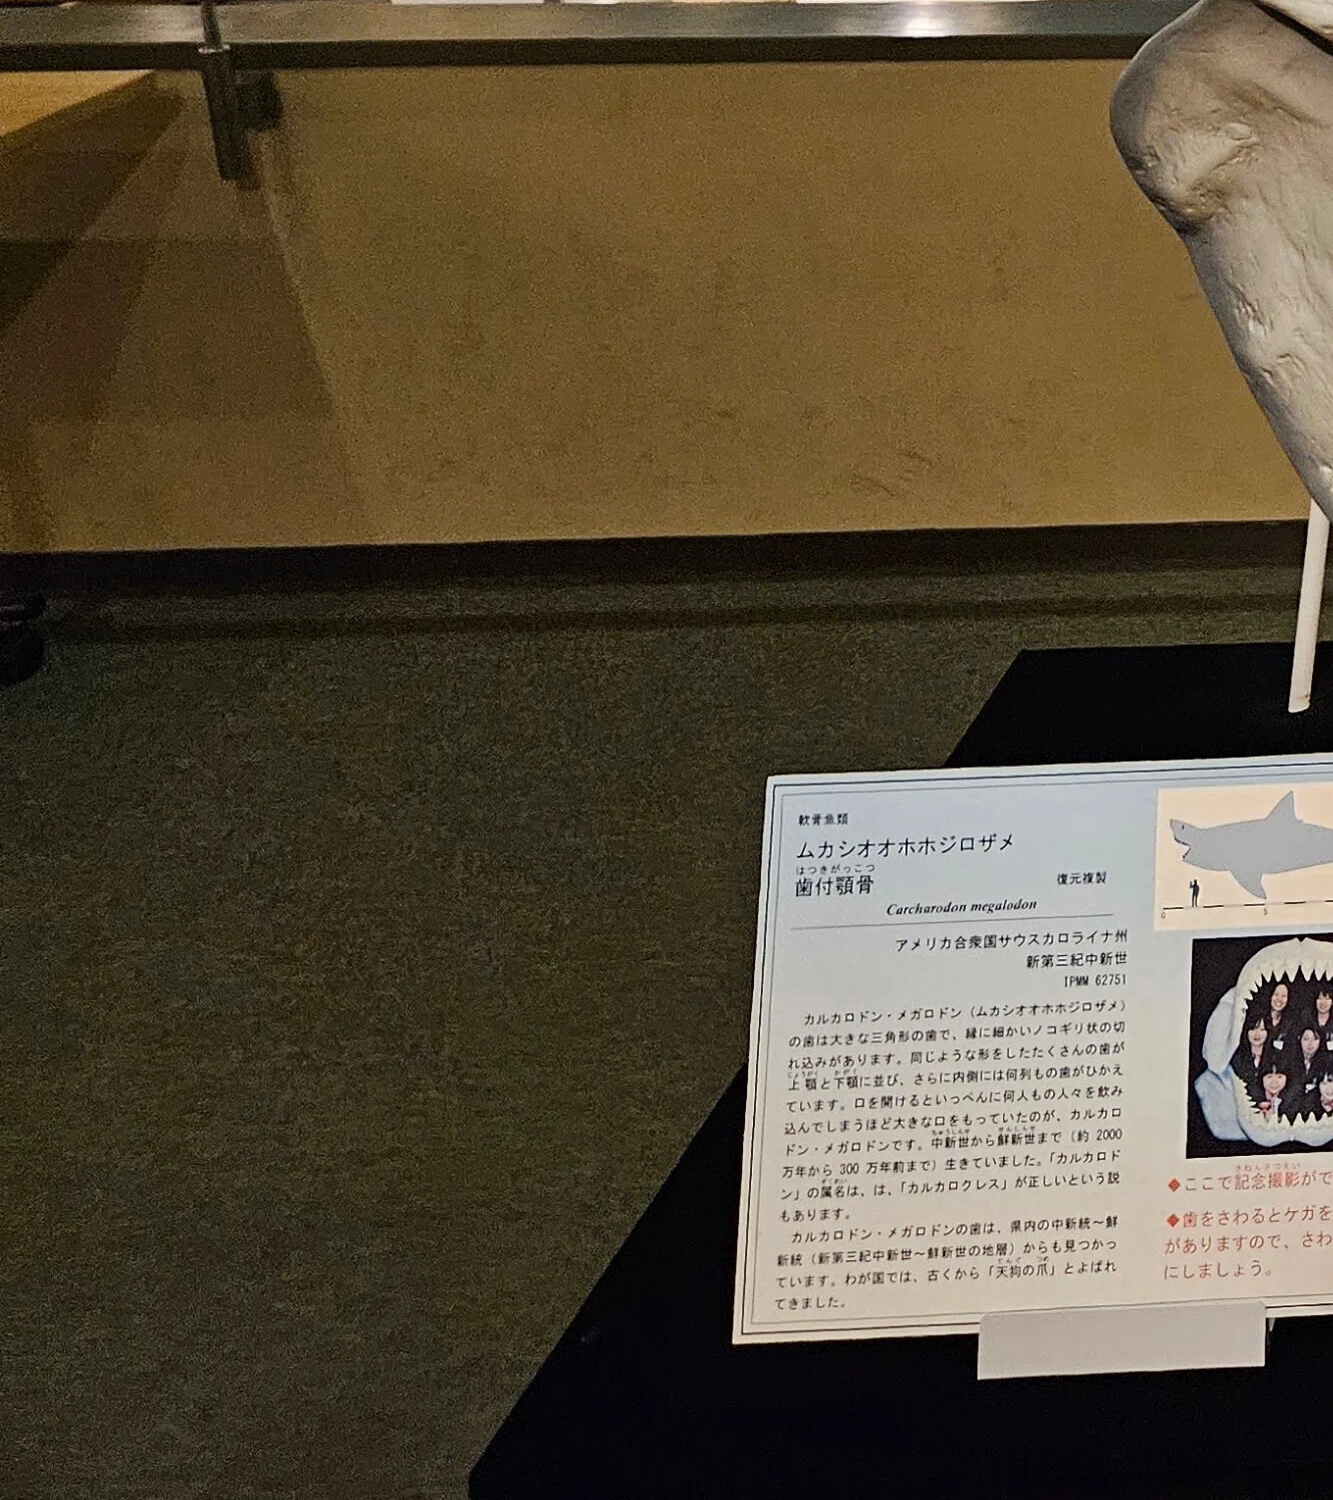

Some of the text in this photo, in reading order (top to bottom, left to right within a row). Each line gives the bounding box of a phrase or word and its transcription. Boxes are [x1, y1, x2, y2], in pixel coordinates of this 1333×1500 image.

[798, 813, 849, 826] 軟骨魚類
[796, 834, 1014, 859] ムカシオオホホジロザメ
[795, 875, 874, 897] 歯付顎骨
[1057, 872, 1107, 885] 復元複製
[887, 899, 1037, 916] Carcharodon megalodon
[896, 929, 1128, 952] アメリカ合衆国サウスカロライナ州
[1026, 952, 1128, 968] 新第三紀中新世
[1095, 973, 1127, 986] 62751
[804, 1000, 1126, 1027] カルカロドン・メガロドン（ムカシオオホホジロザメ）
[788, 1043, 1126, 1069] れ込みがあります。同じような形をしたたくさんの歯が
[779, 1208, 852, 1221] もあります。
[1164, 1259, 1272, 1280] にしましょう。
[774, 1296, 847, 1311] てきました。
